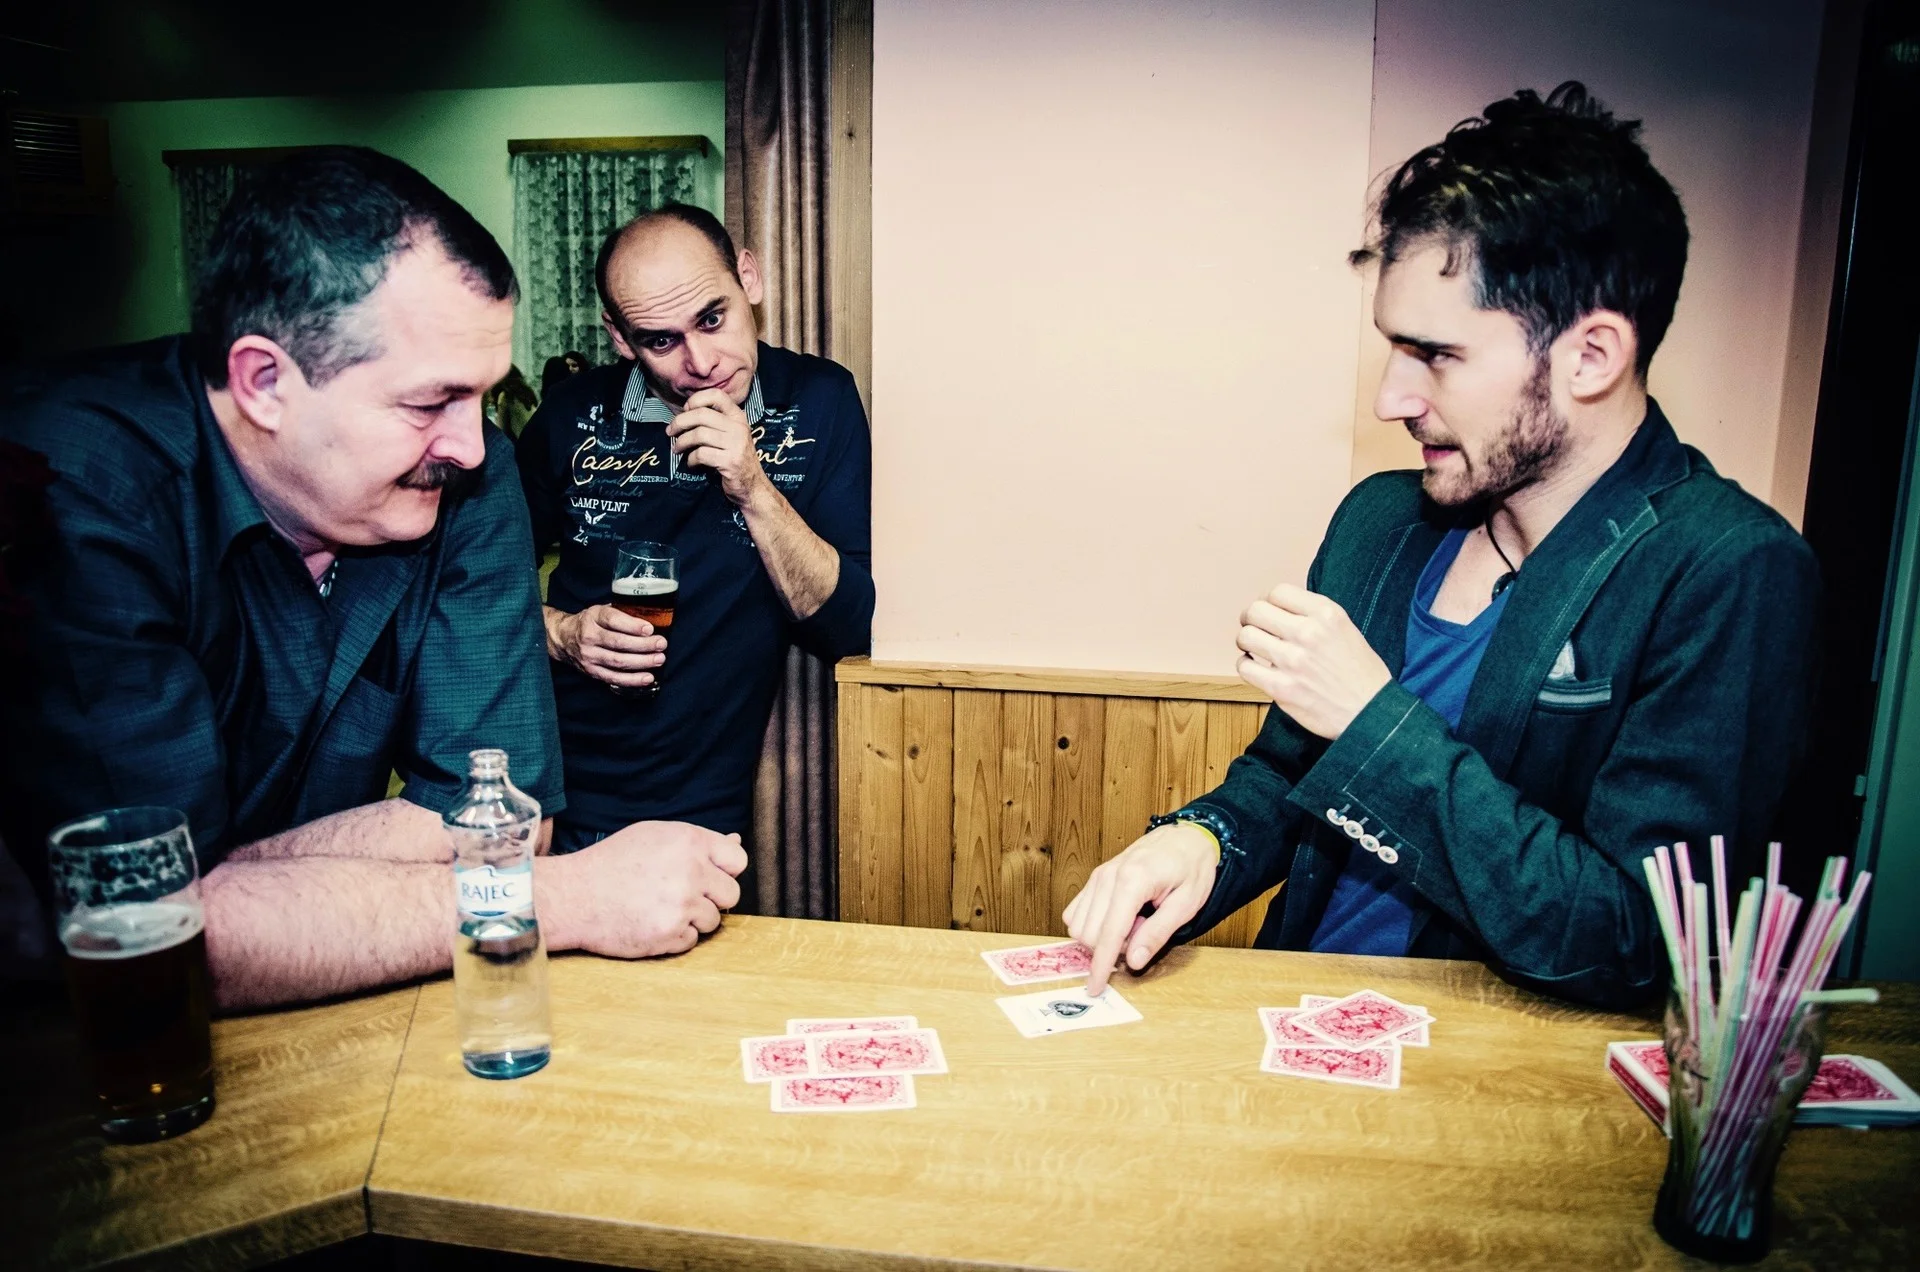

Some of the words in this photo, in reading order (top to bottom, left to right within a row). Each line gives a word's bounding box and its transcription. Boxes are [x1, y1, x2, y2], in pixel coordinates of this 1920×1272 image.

[571, 435, 661, 487] Camp
[569, 496, 600, 510] CAMP
[600, 499, 631, 513] VLNT
[461, 882, 516, 903] RAJEC
